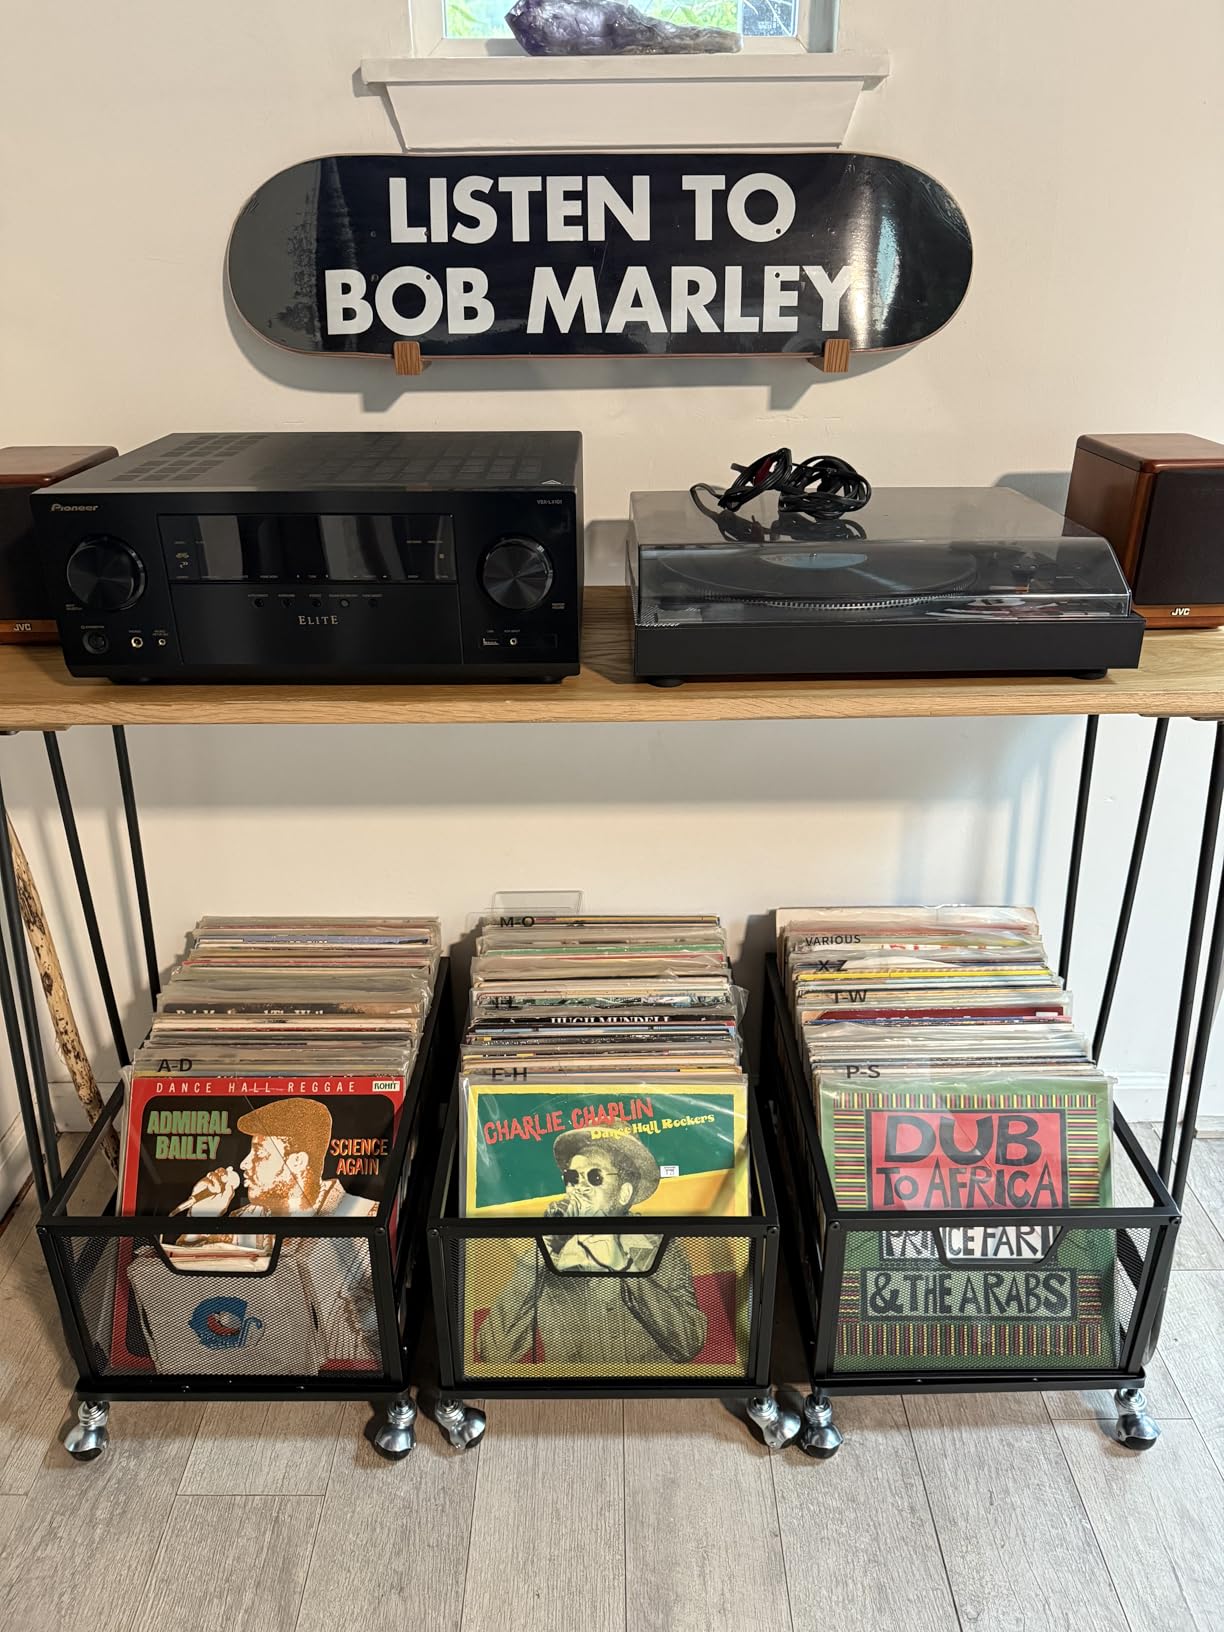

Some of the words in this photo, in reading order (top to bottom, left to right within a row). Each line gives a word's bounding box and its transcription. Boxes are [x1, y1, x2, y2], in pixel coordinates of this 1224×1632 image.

[389, 174, 651, 244] LISTEN
[682, 173, 797, 243] TO
[324, 266, 496, 336] BOB
[527, 265, 852, 335] MARLEY
[500, 916, 536, 928] M-O
[806, 935, 861, 945] VARIOUS
[831, 990, 867, 1003] T-W
[157, 1058, 193, 1072] A-D
[846, 1065, 881, 1079] P-S
[157, 1083, 212, 1093] DANCE
[228, 1082, 271, 1093] HALL
[288, 1081, 355, 1092] REGGAE
[374, 1082, 399, 1091] ROHIT
[147, 1110, 232, 1135] ADMIRAL
[484, 1110, 565, 1145] CHARLIE
[569, 1098, 654, 1130] CHAPLIN
[590, 1126, 632, 1140] Dance
[632, 1121, 661, 1135] Hall
[662, 1114, 716, 1131] Rockers
[155, 1136, 221, 1161] BAILEY
[330, 1138, 388, 1157] SCIENCE
[884, 1114, 1042, 1166] DUB
[336, 1157, 379, 1176] AGAIN
[925, 1158, 1060, 1209] AFRICA
[870, 1272, 904, 1314] &
[903, 1273, 952, 1315] THE
[959, 1272, 1069, 1315] ARABS
